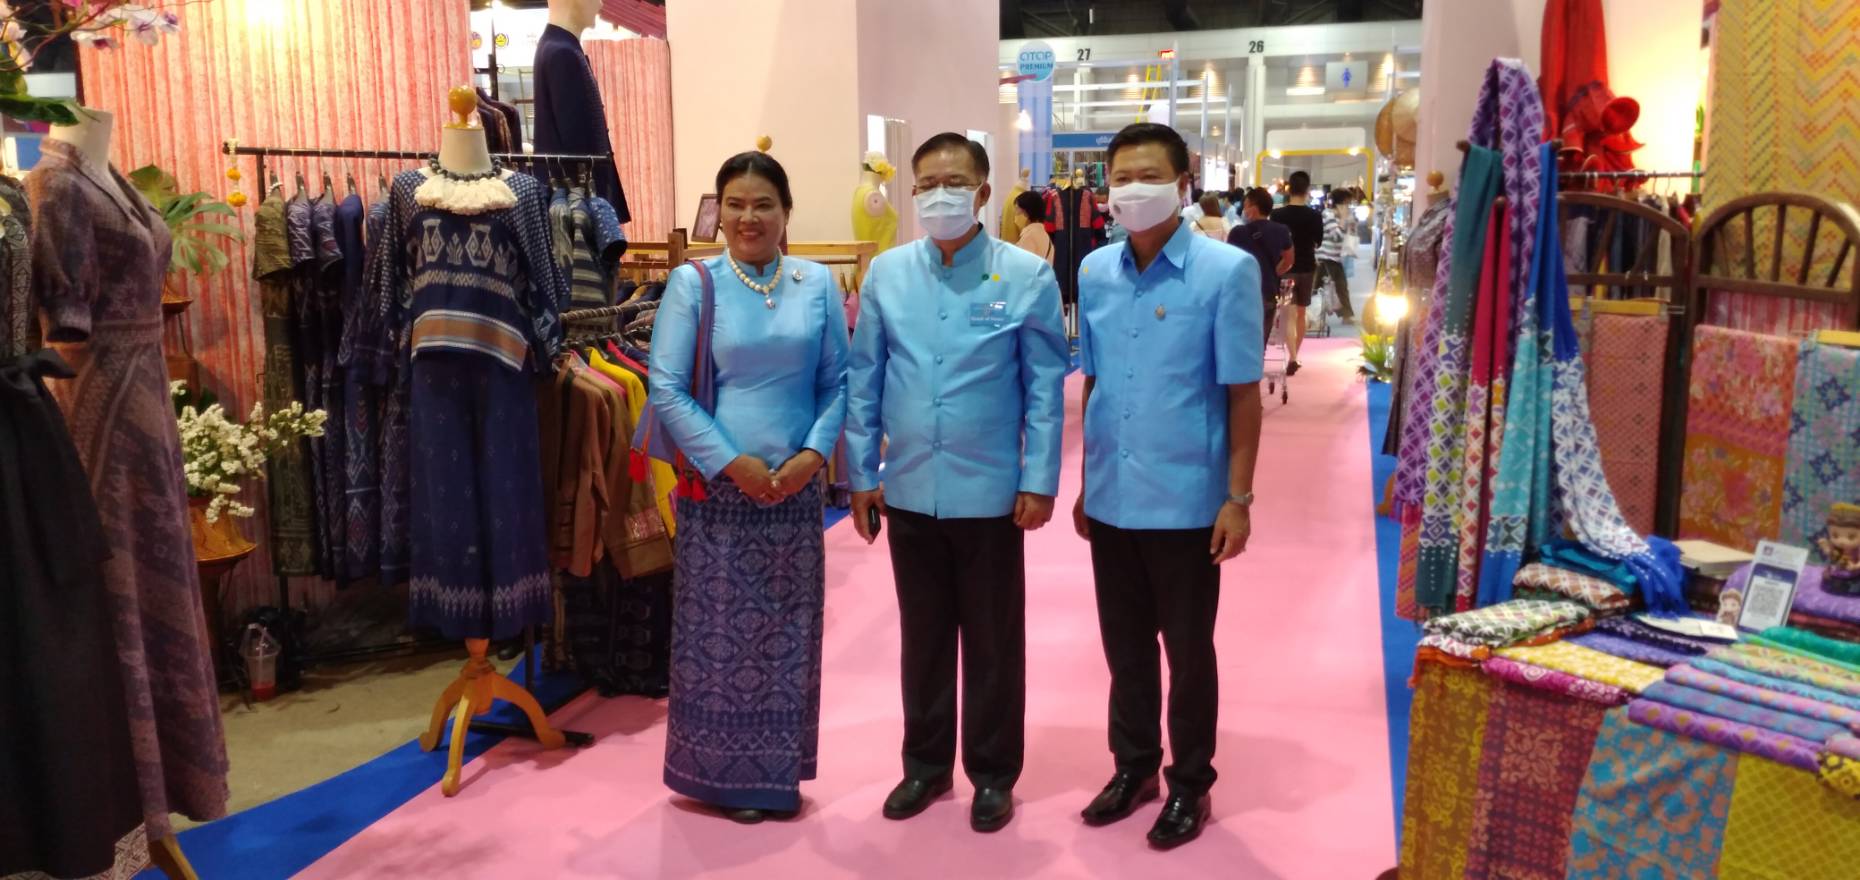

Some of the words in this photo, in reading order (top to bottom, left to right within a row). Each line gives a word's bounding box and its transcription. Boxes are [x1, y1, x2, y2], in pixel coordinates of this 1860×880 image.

[1248, 40, 1265, 54] 26
[1020, 51, 1053, 61] OTOP
[1077, 48, 1091, 61] 27
[1020, 62, 1053, 70] PREMIUM
